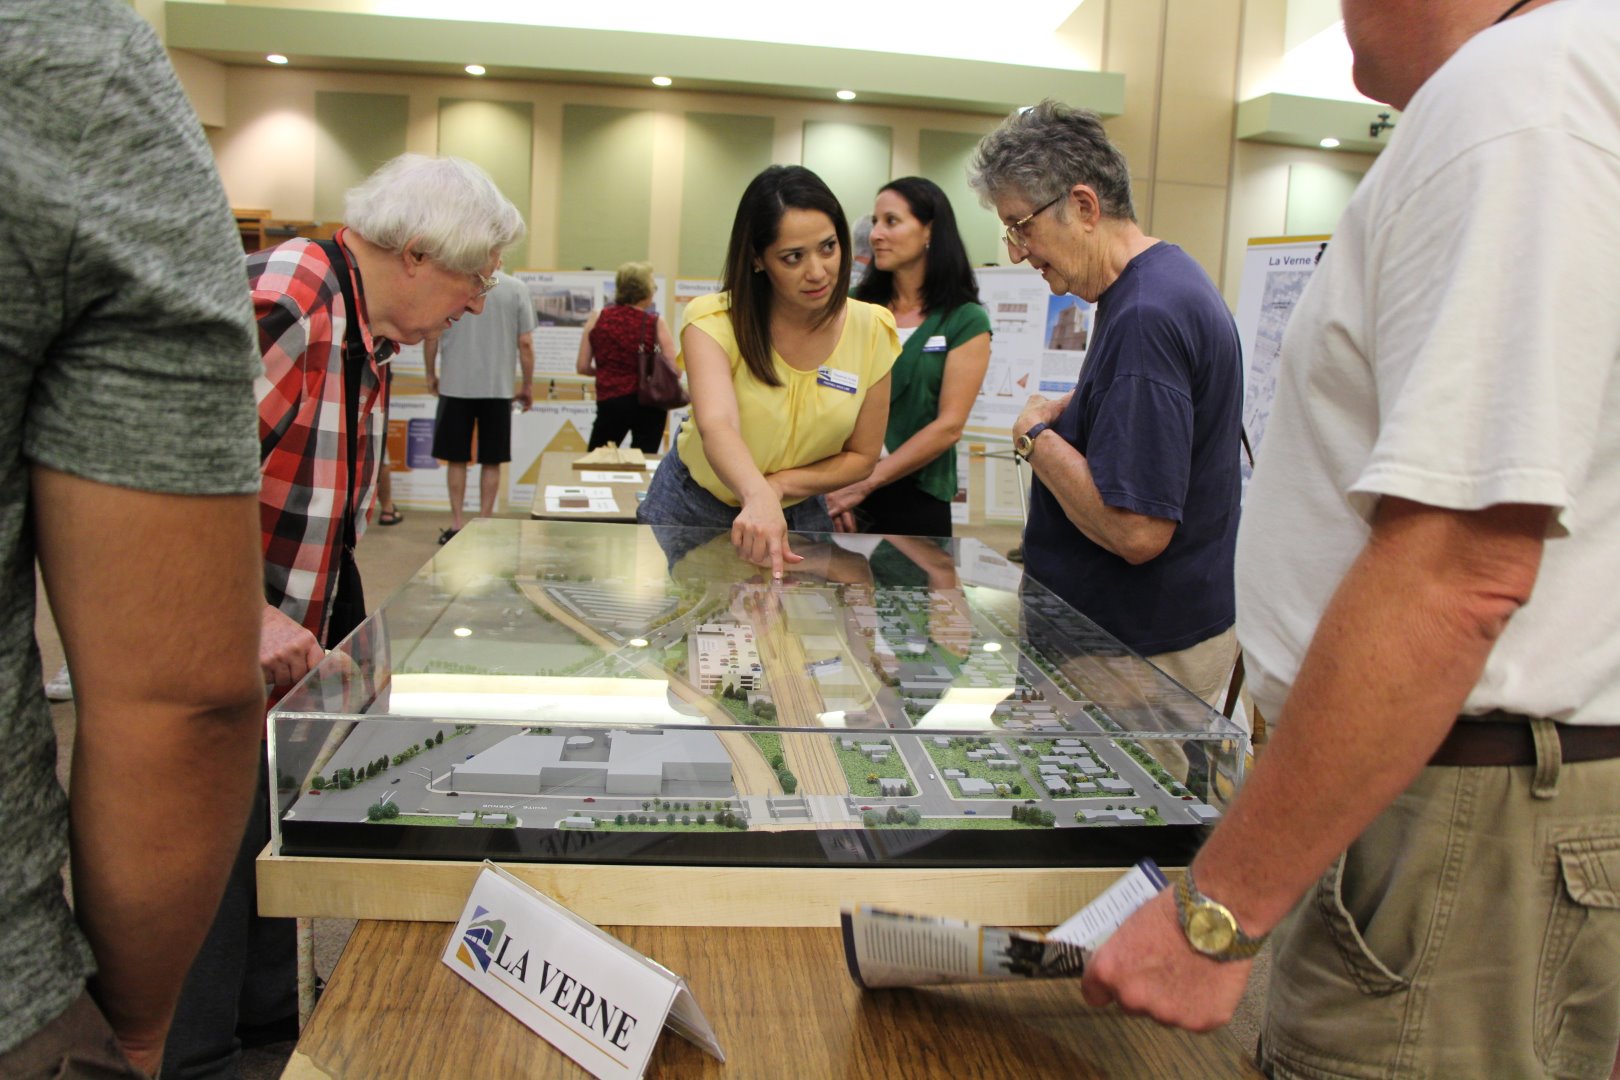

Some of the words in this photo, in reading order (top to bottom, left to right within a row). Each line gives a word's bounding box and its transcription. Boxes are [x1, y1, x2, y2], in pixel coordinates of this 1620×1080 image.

[1269, 257, 1280, 266] La
[1284, 256, 1311, 265] Verne
[561, 406, 589, 414] Project
[494, 934, 530, 983] LA
[539, 960, 638, 1052] VERNE
